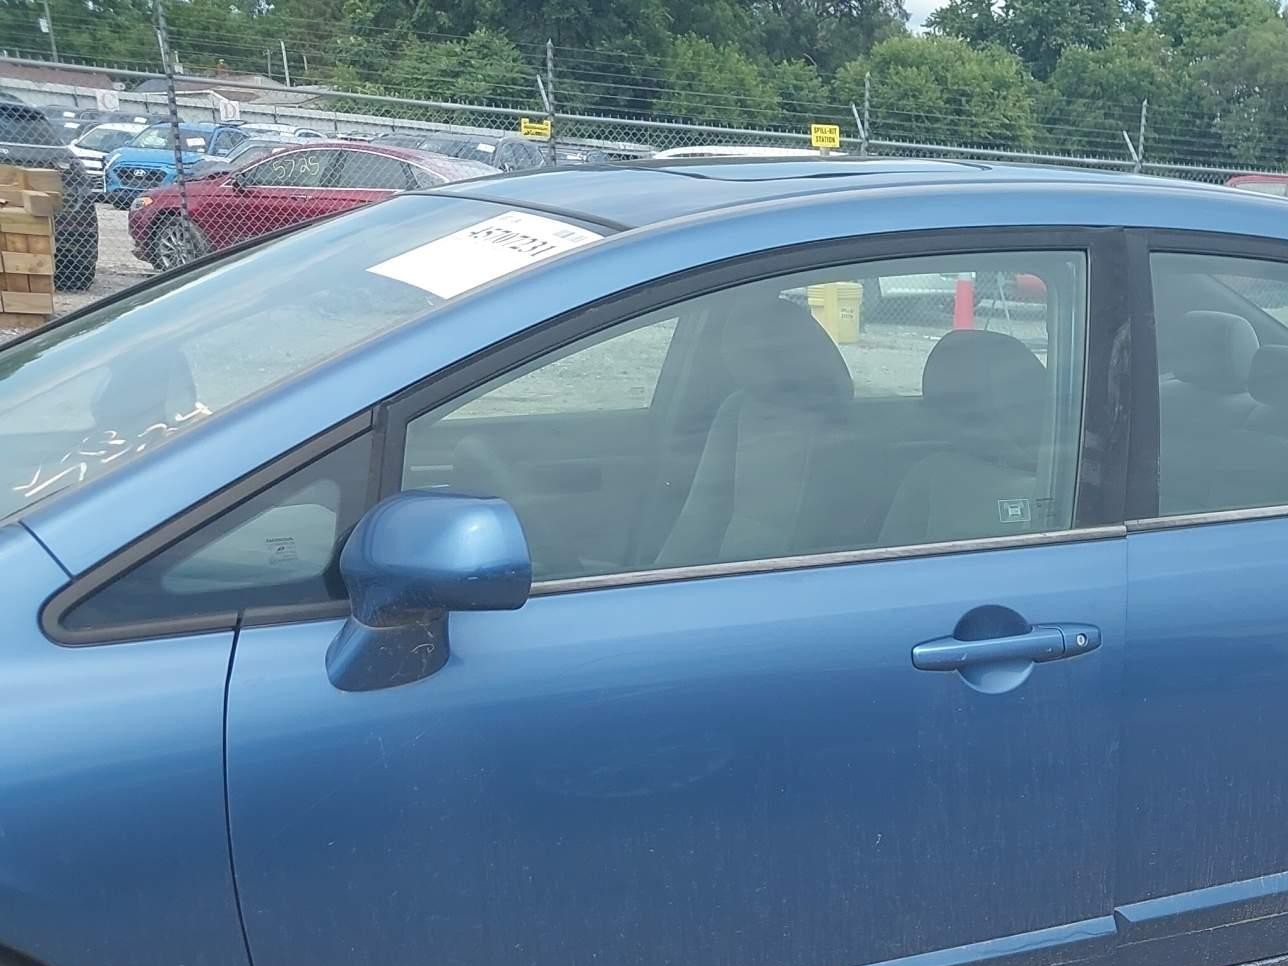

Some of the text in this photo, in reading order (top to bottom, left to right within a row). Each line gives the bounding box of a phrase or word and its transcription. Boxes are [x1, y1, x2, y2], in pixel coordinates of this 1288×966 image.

[224, 102, 236, 119] D
[815, 135, 836, 143] STATION
[273, 156, 320, 179] 5725
[468, 225, 556, 257] 45707231
